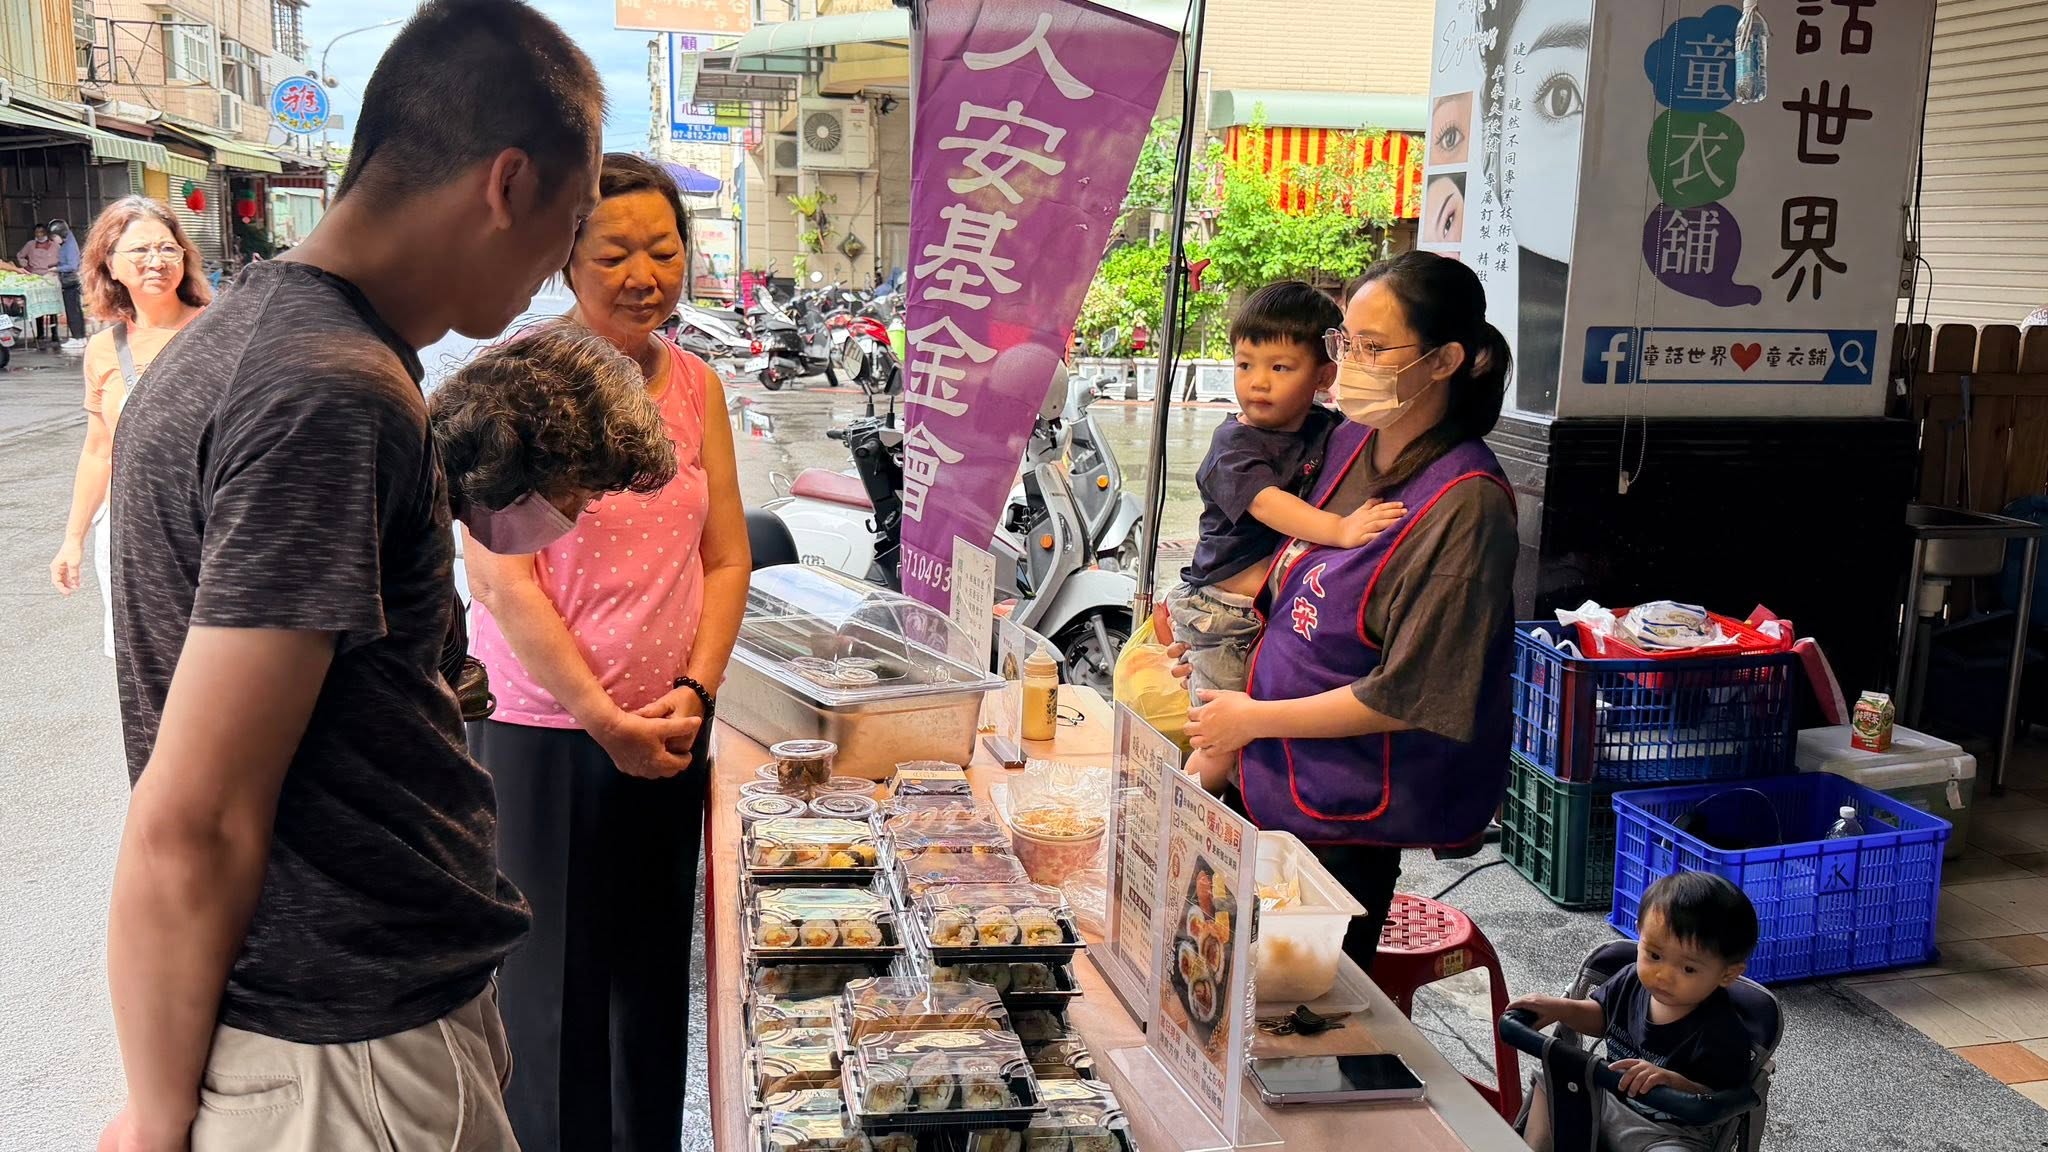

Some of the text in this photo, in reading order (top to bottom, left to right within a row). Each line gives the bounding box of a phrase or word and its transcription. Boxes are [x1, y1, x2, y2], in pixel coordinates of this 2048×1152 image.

[901, 12, 1094, 523] 人安基金會
[1659, 33, 1736, 275] 童衣舖
[1770, 0, 1875, 302] 話世界
[1643, 346, 1727, 367] 童話世界
[1766, 347, 1828, 367] 童衣舖
[1291, 562, 1326, 641] 人安
